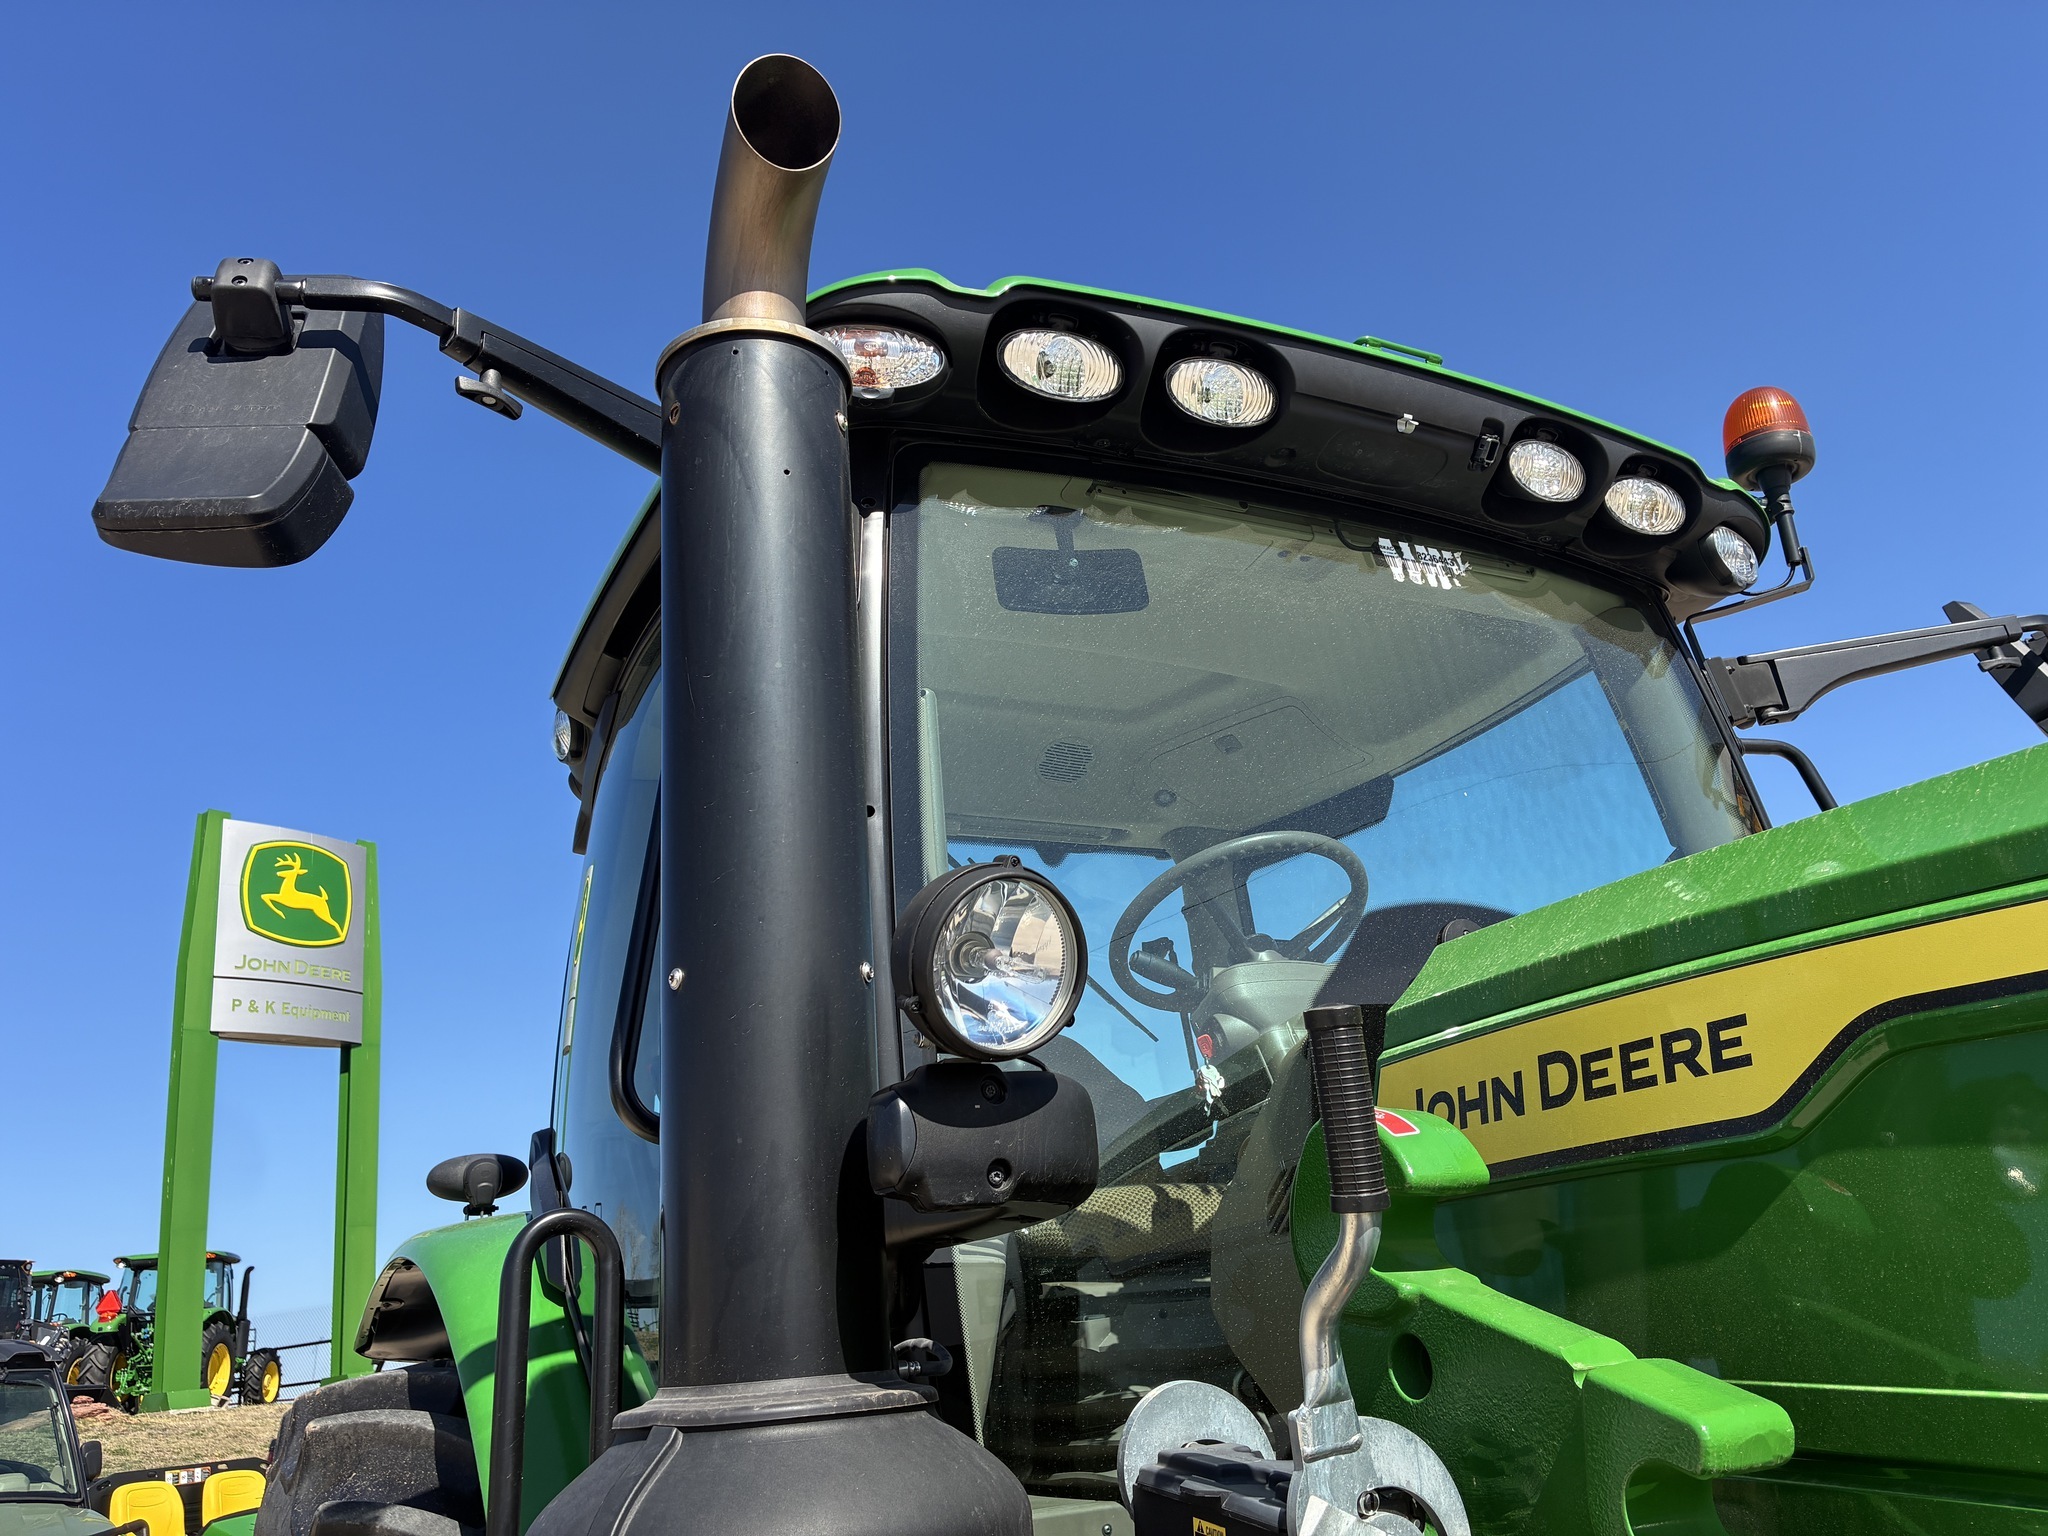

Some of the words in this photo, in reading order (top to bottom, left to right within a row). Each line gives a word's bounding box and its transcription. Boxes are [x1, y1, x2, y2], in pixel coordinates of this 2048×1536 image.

[235, 954, 291, 975] JOHN
[294, 960, 351, 983] DEERE
[231, 999, 242, 1012] P
[248, 1000, 259, 1013] &
[265, 1001, 276, 1015] K
[282, 1002, 351, 1024] Equipment
[1538, 1013, 1753, 1111] DEERE
